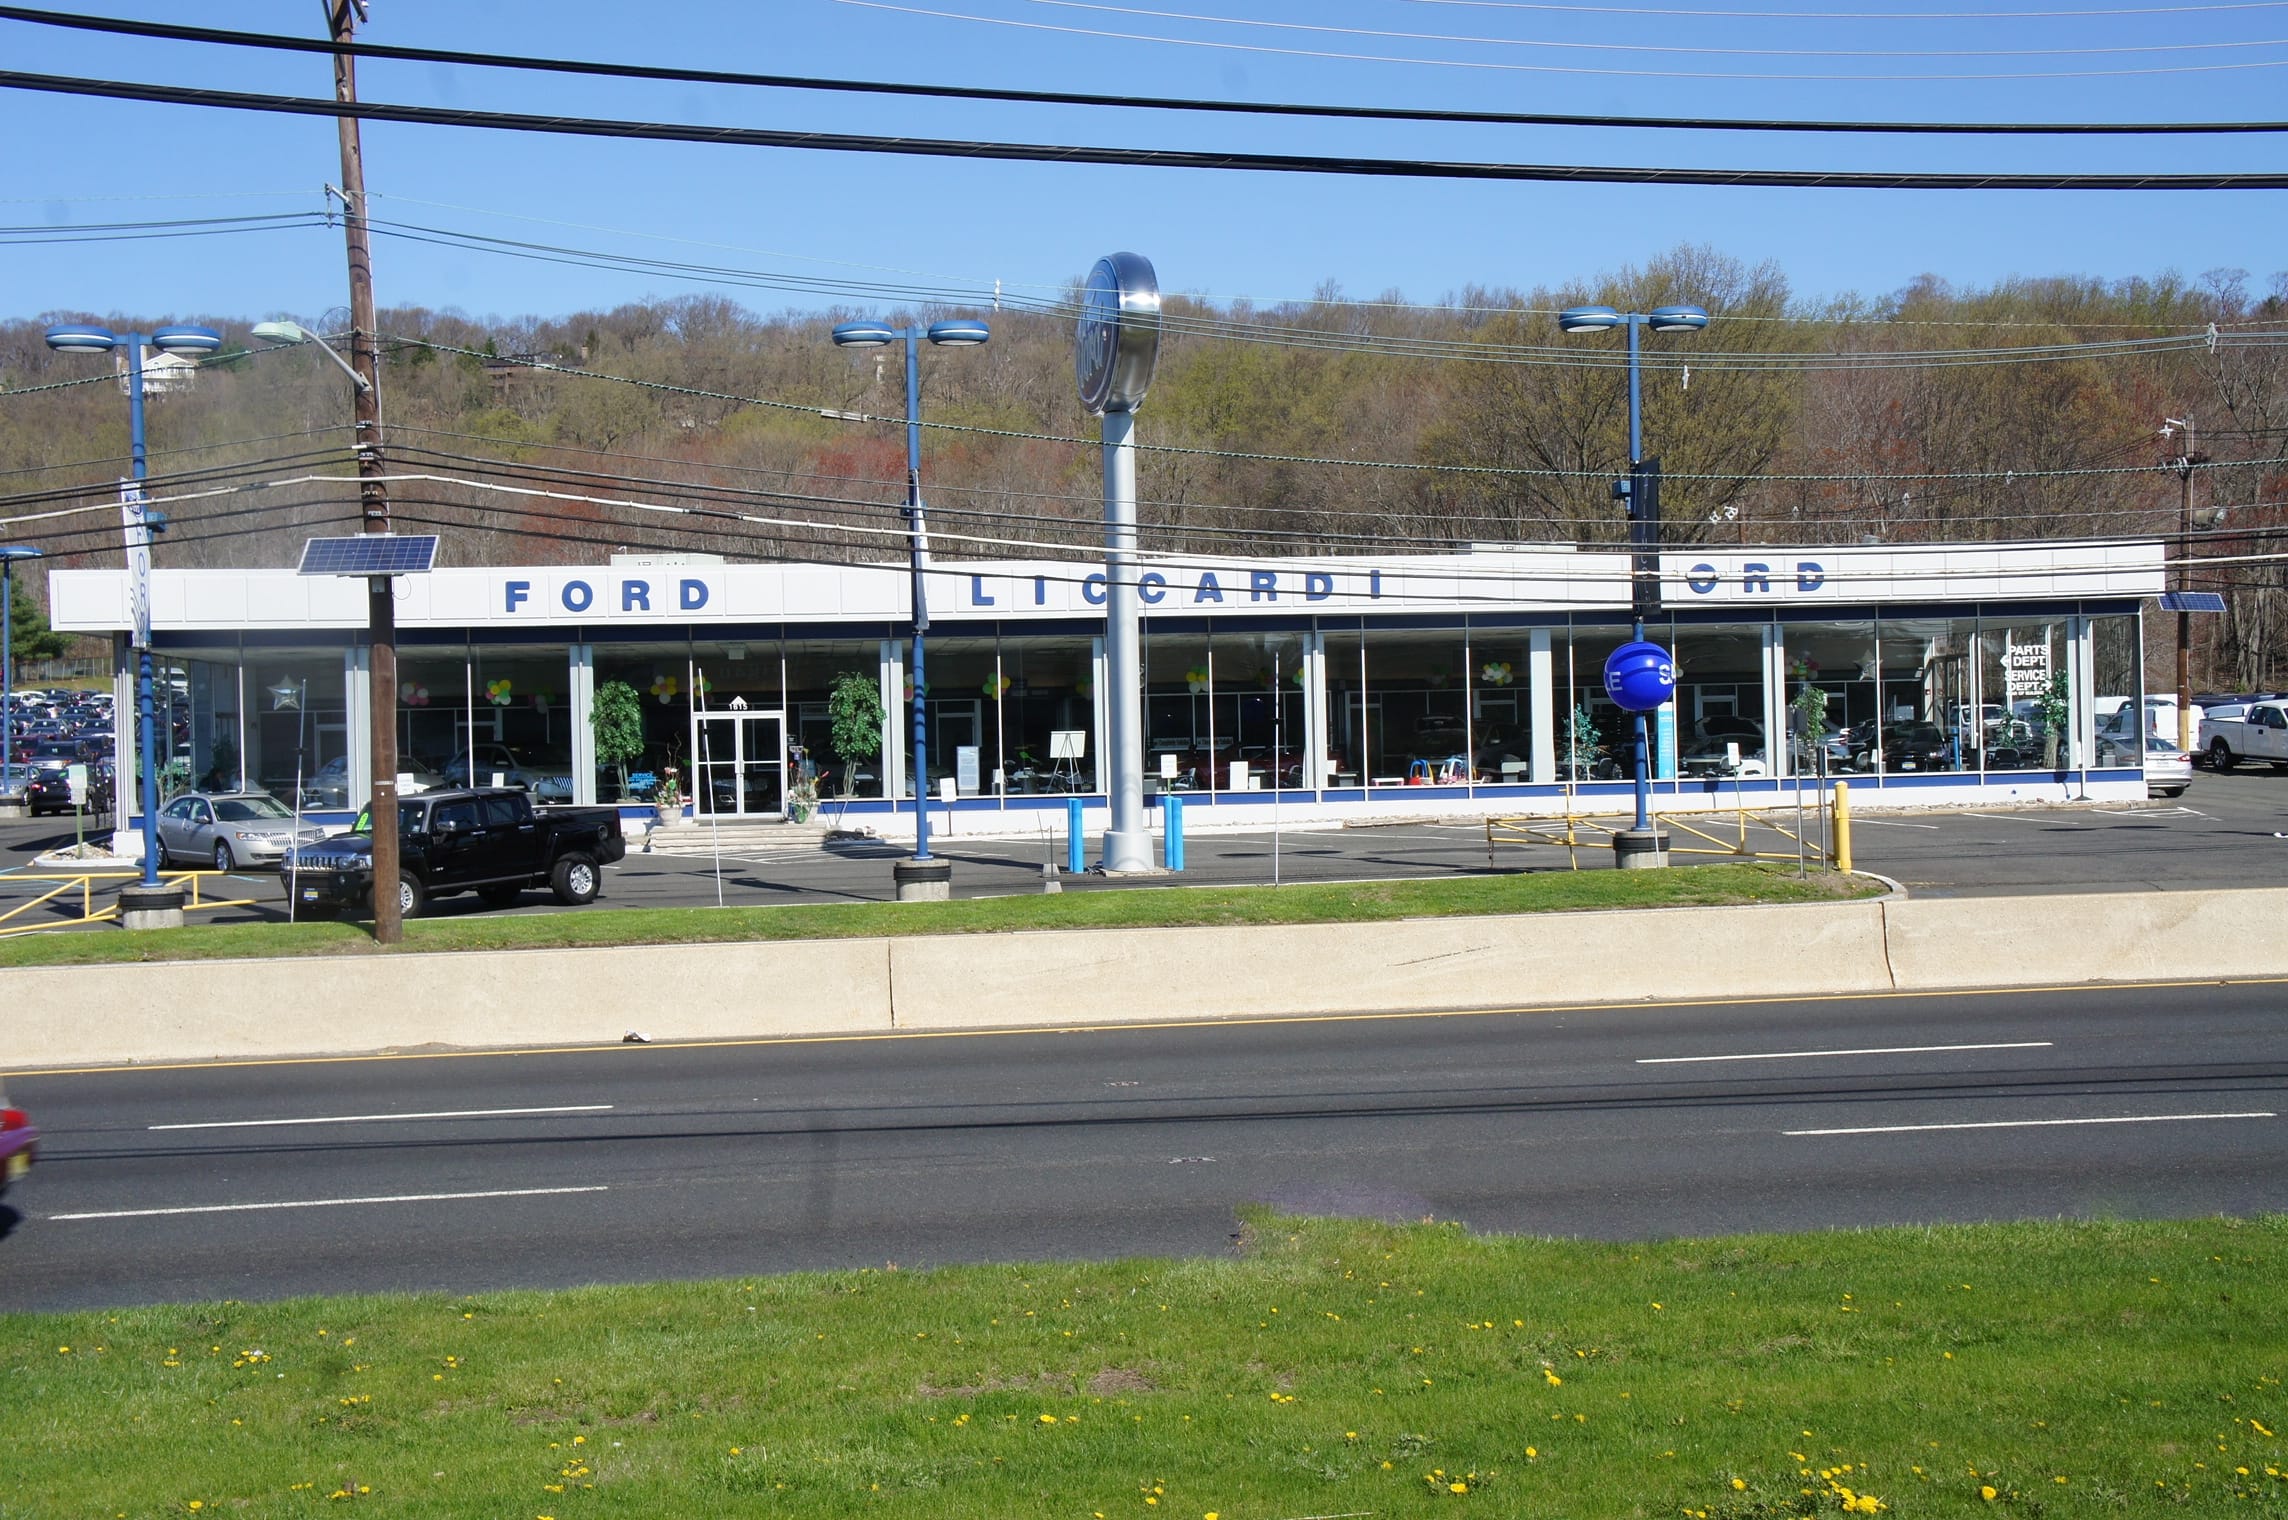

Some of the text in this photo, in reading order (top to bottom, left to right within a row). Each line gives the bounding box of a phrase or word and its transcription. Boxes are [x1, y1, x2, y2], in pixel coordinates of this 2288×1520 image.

[1688, 562, 1824, 595] ORD
[972, 569, 1380, 606] LICCARDI
[505, 579, 709, 612] FORD
[2009, 644, 2050, 656] PARTS
[2005, 669, 2046, 681] SERVICE
[2006, 681, 2043, 691] DEPT.
[729, 703, 748, 711] 1615
